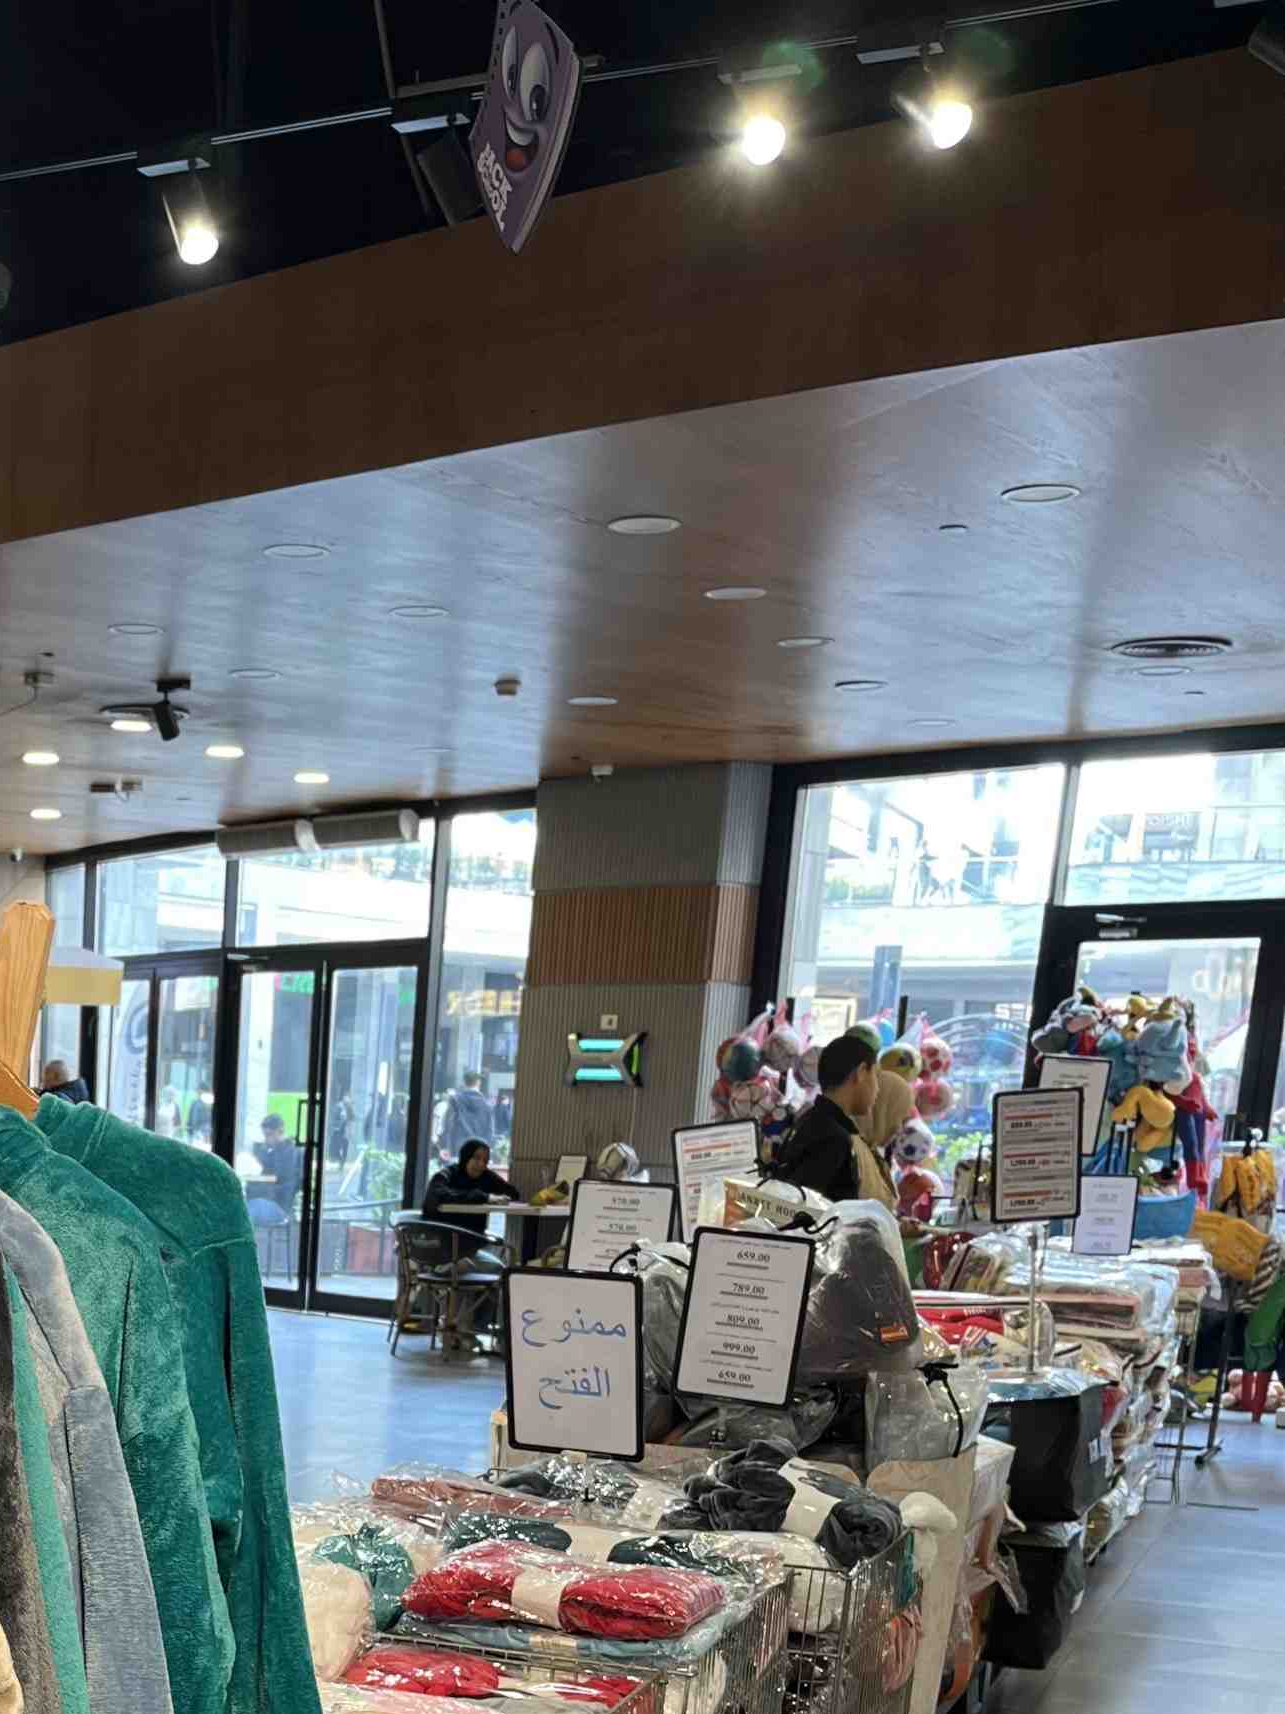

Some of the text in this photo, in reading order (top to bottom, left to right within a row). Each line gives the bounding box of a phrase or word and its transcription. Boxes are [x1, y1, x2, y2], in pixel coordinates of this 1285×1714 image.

[736, 1250, 771, 1263] 659.00
[732, 1282, 765, 1294] 789.00
[521, 1308, 627, 1348] ممنوع
[723, 1341, 757, 1354] 999.00
[718, 1370, 752, 1383] 659.00
[538, 1365, 611, 1411] الفتح
